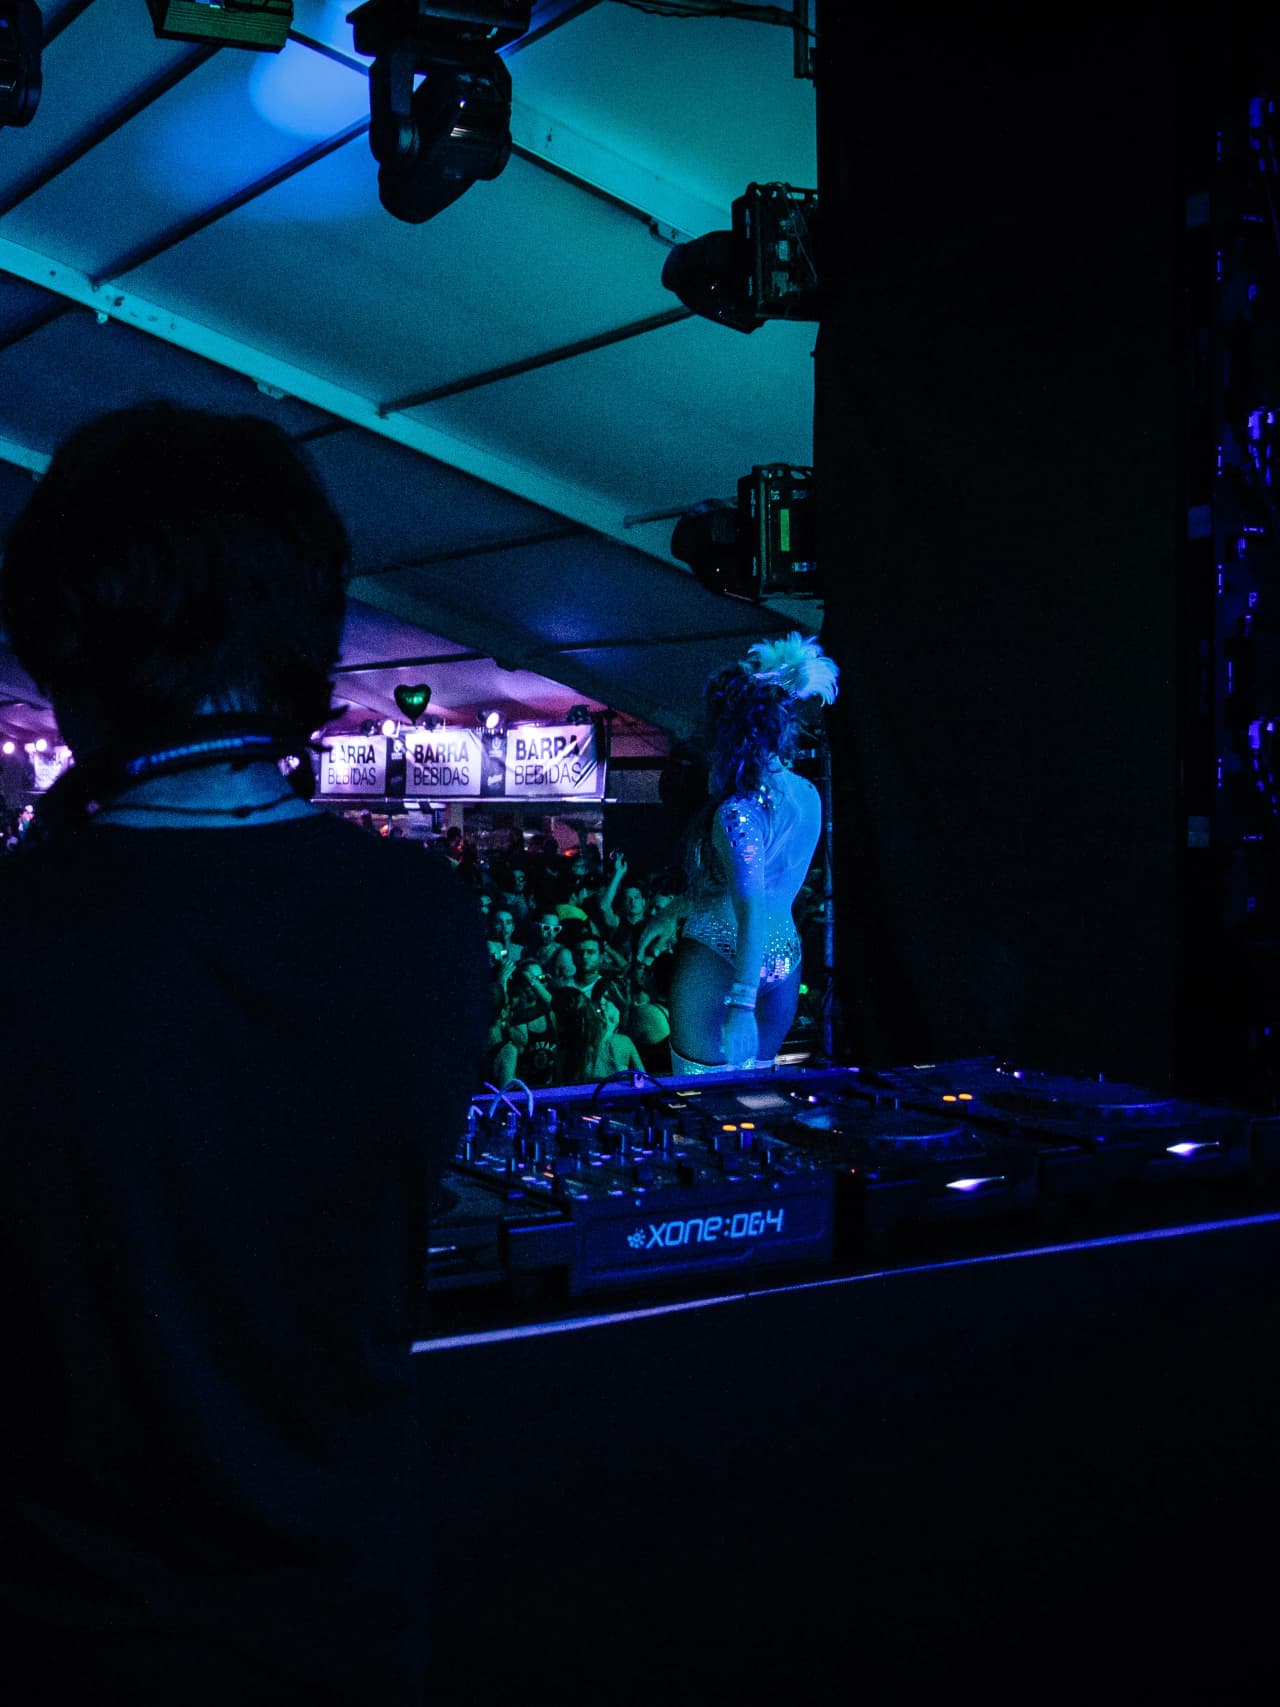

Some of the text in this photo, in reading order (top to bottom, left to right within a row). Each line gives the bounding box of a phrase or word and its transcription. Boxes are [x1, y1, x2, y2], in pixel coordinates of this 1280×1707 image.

[415, 742, 469, 763] BARRA
[414, 767, 469, 786] BEBIDAS
[515, 761, 581, 785] BEBIDAS
